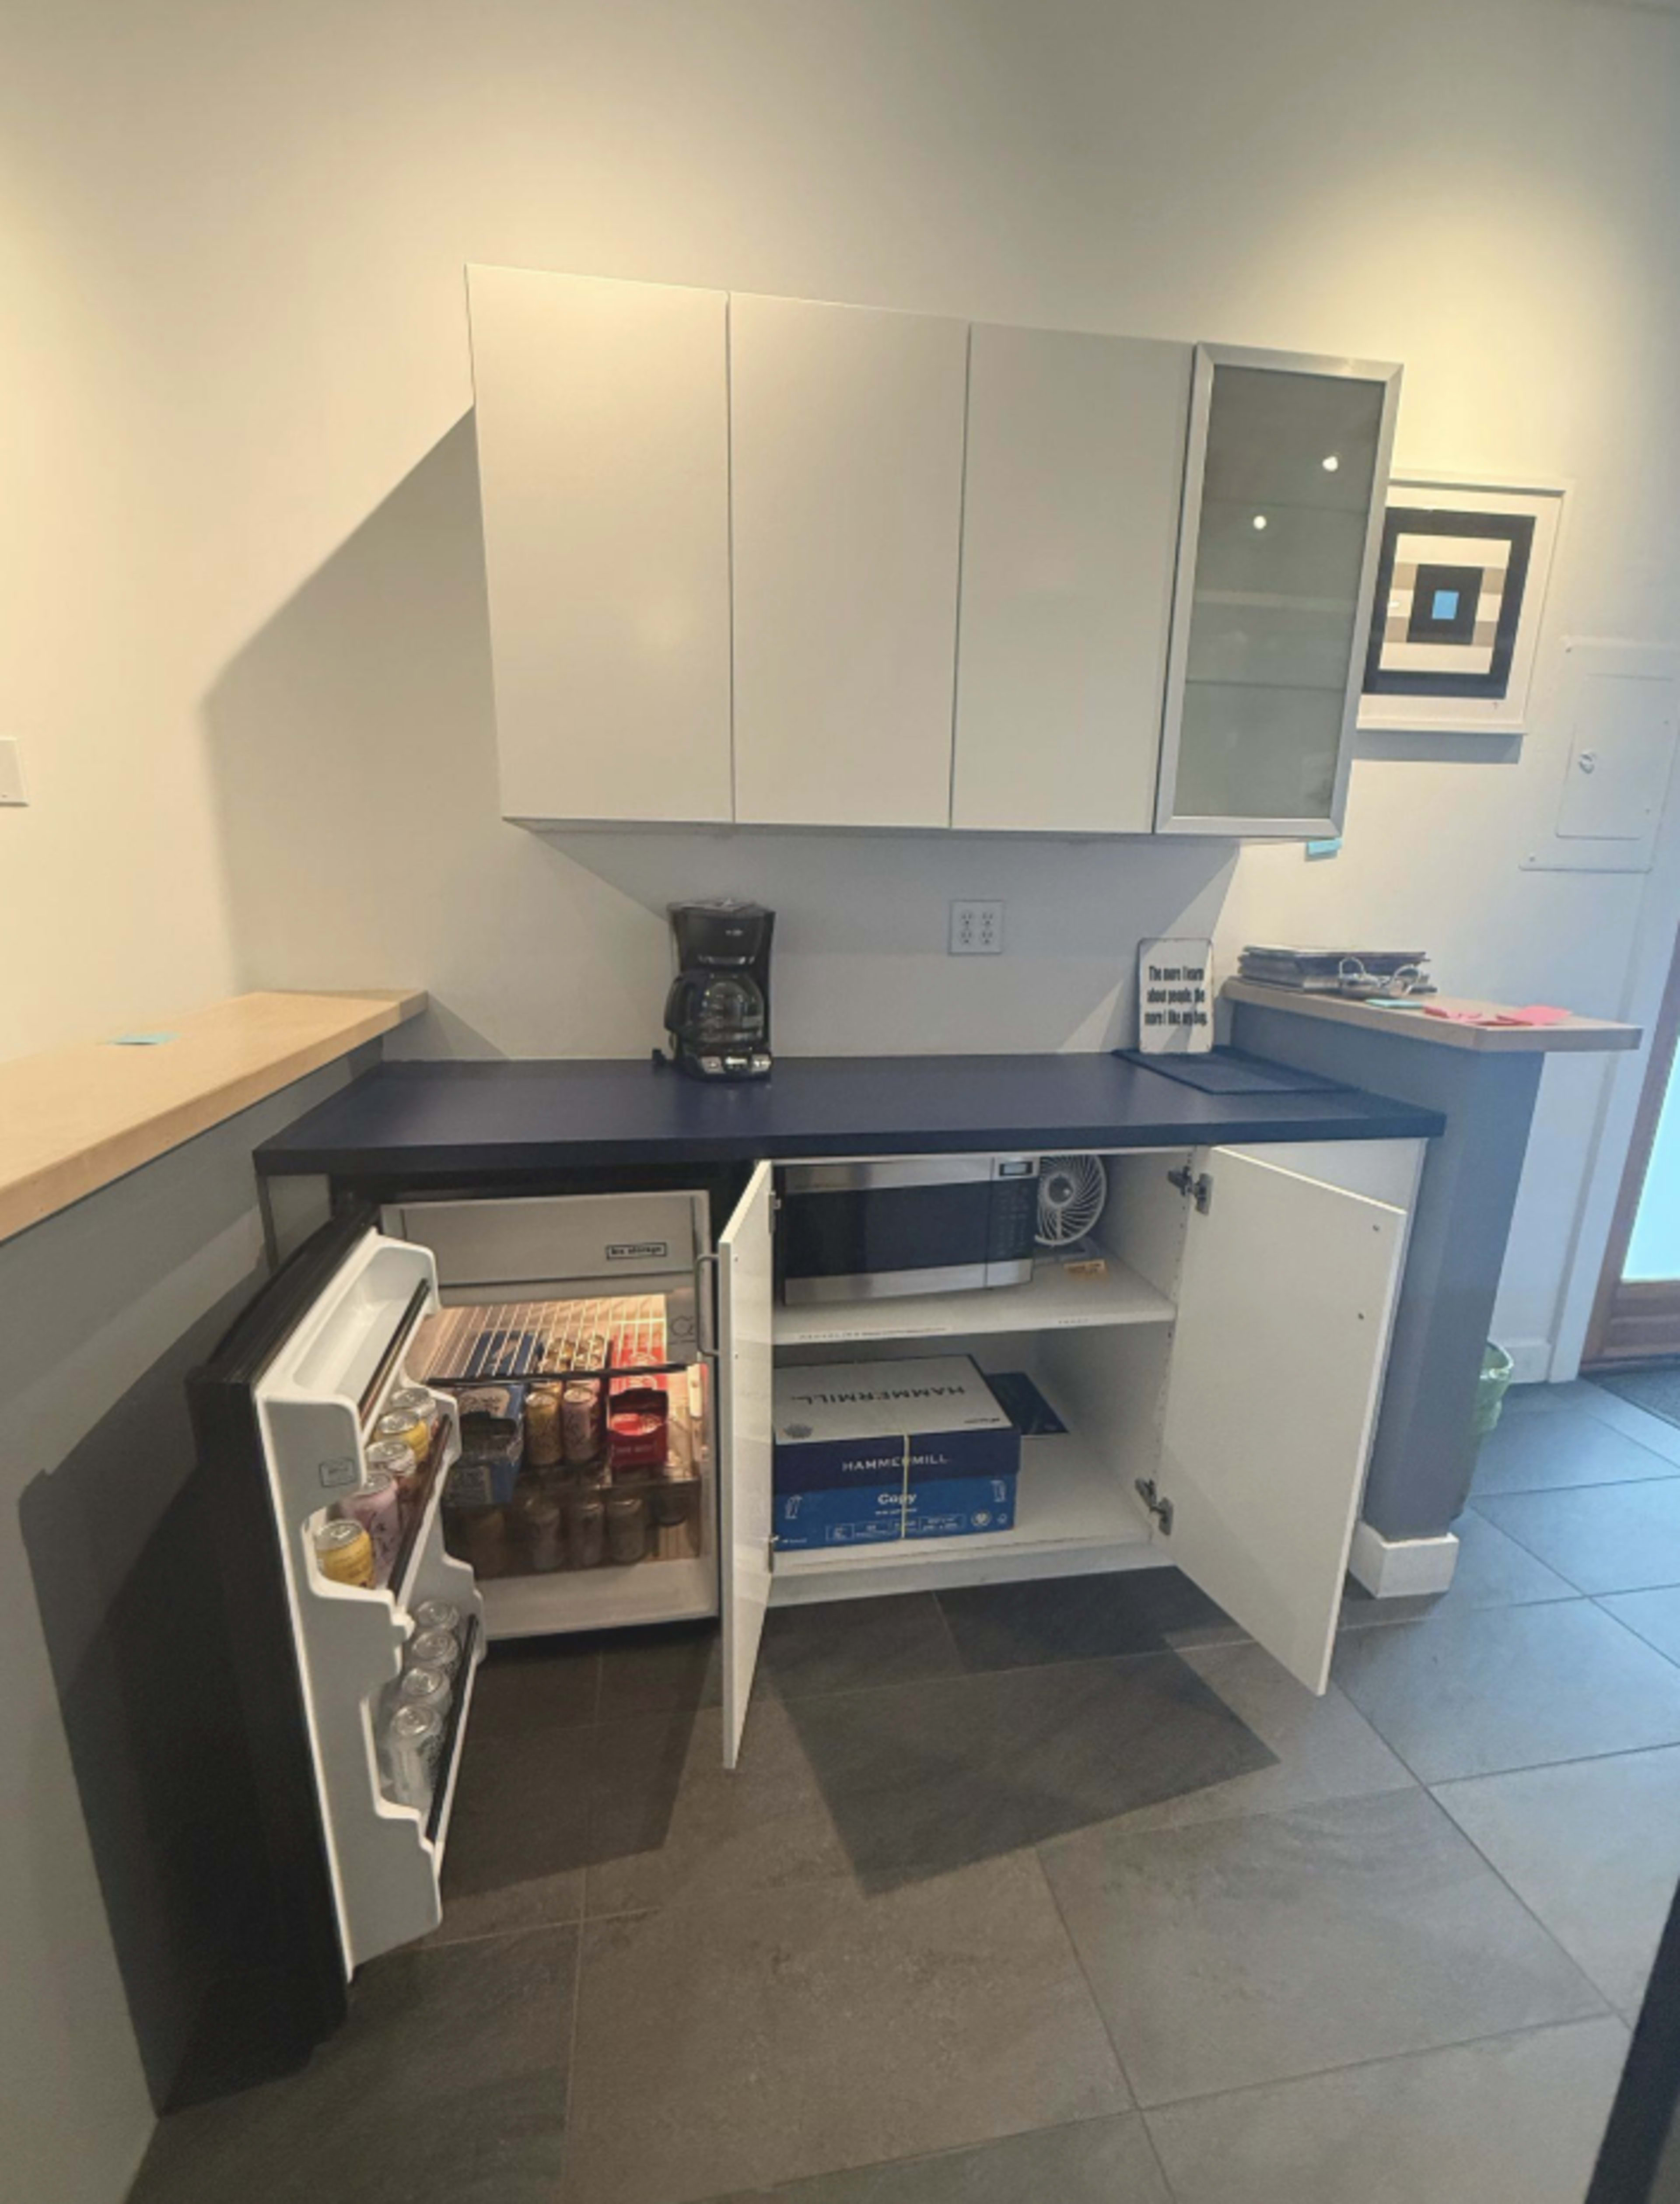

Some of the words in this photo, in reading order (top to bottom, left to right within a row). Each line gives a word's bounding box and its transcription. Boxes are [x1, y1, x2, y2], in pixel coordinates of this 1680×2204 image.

[1148, 965, 1162, 981] The
[1163, 967, 1181, 981] more
[1186, 965, 1204, 981] learn
[1147, 987, 1166, 1003] about
[1194, 987, 1205, 1003] the
[1144, 1012, 1162, 1025] more
[1168, 1009, 1181, 1025] like
